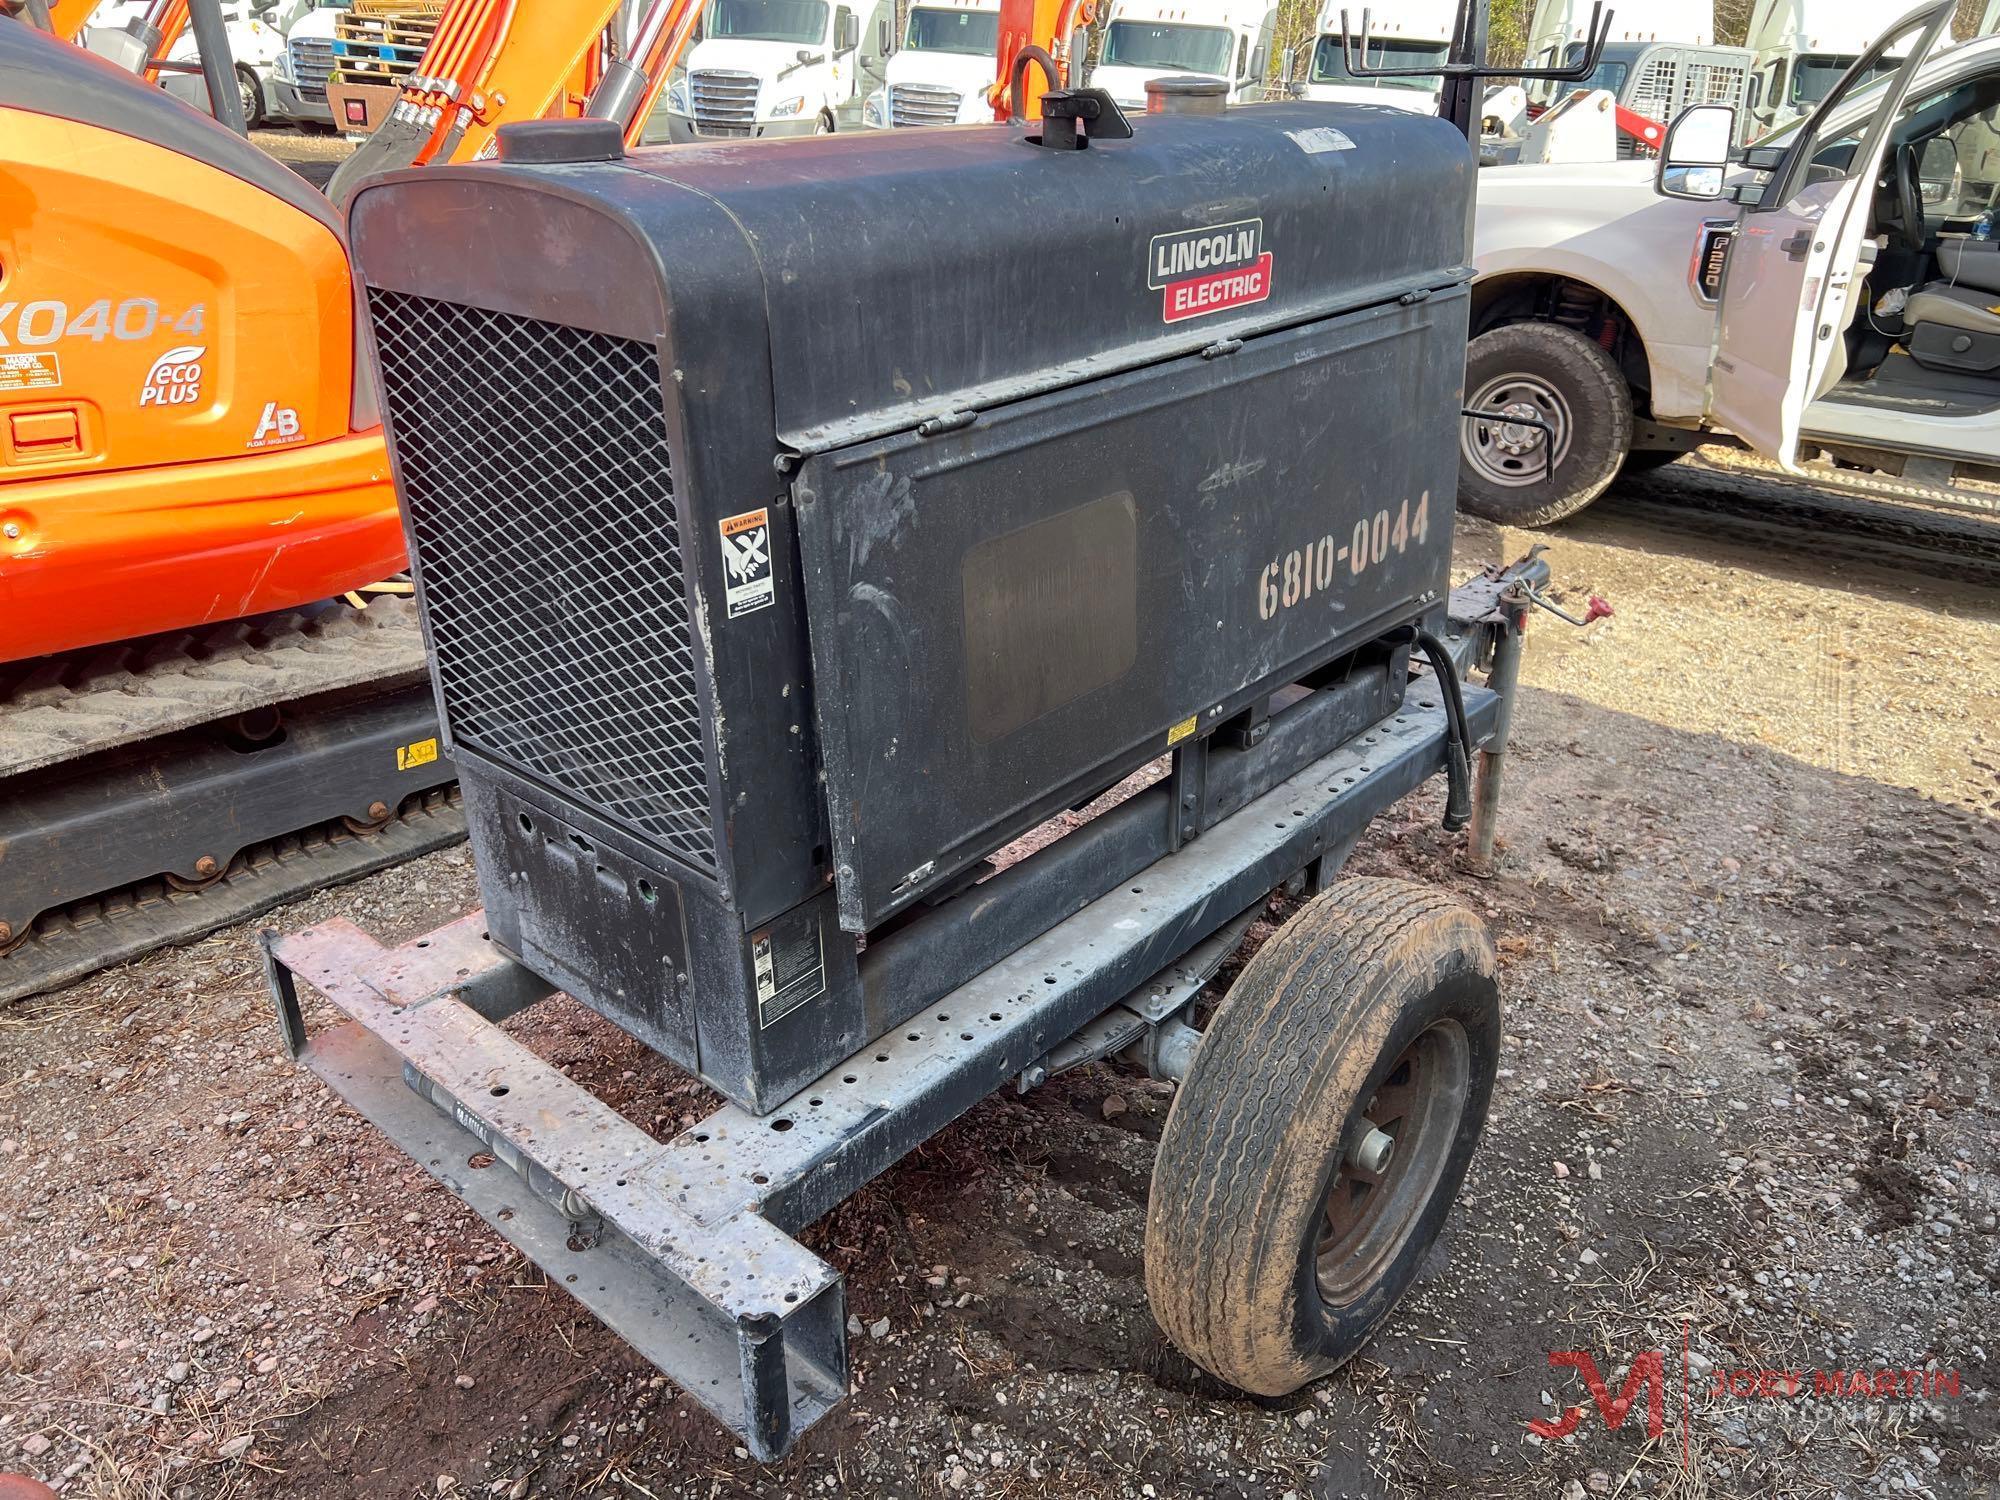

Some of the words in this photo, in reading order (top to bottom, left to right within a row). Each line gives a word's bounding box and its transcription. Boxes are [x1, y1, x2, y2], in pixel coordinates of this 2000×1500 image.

[1157, 229, 1255, 277] LINCOLN
[1175, 272, 1262, 312] ELECTRIC
[156, 363, 202, 385] eco
[139, 383, 200, 407] PLUS
[732, 514, 763, 528] WARNING
[1259, 489, 1429, 621] 6810-0044
